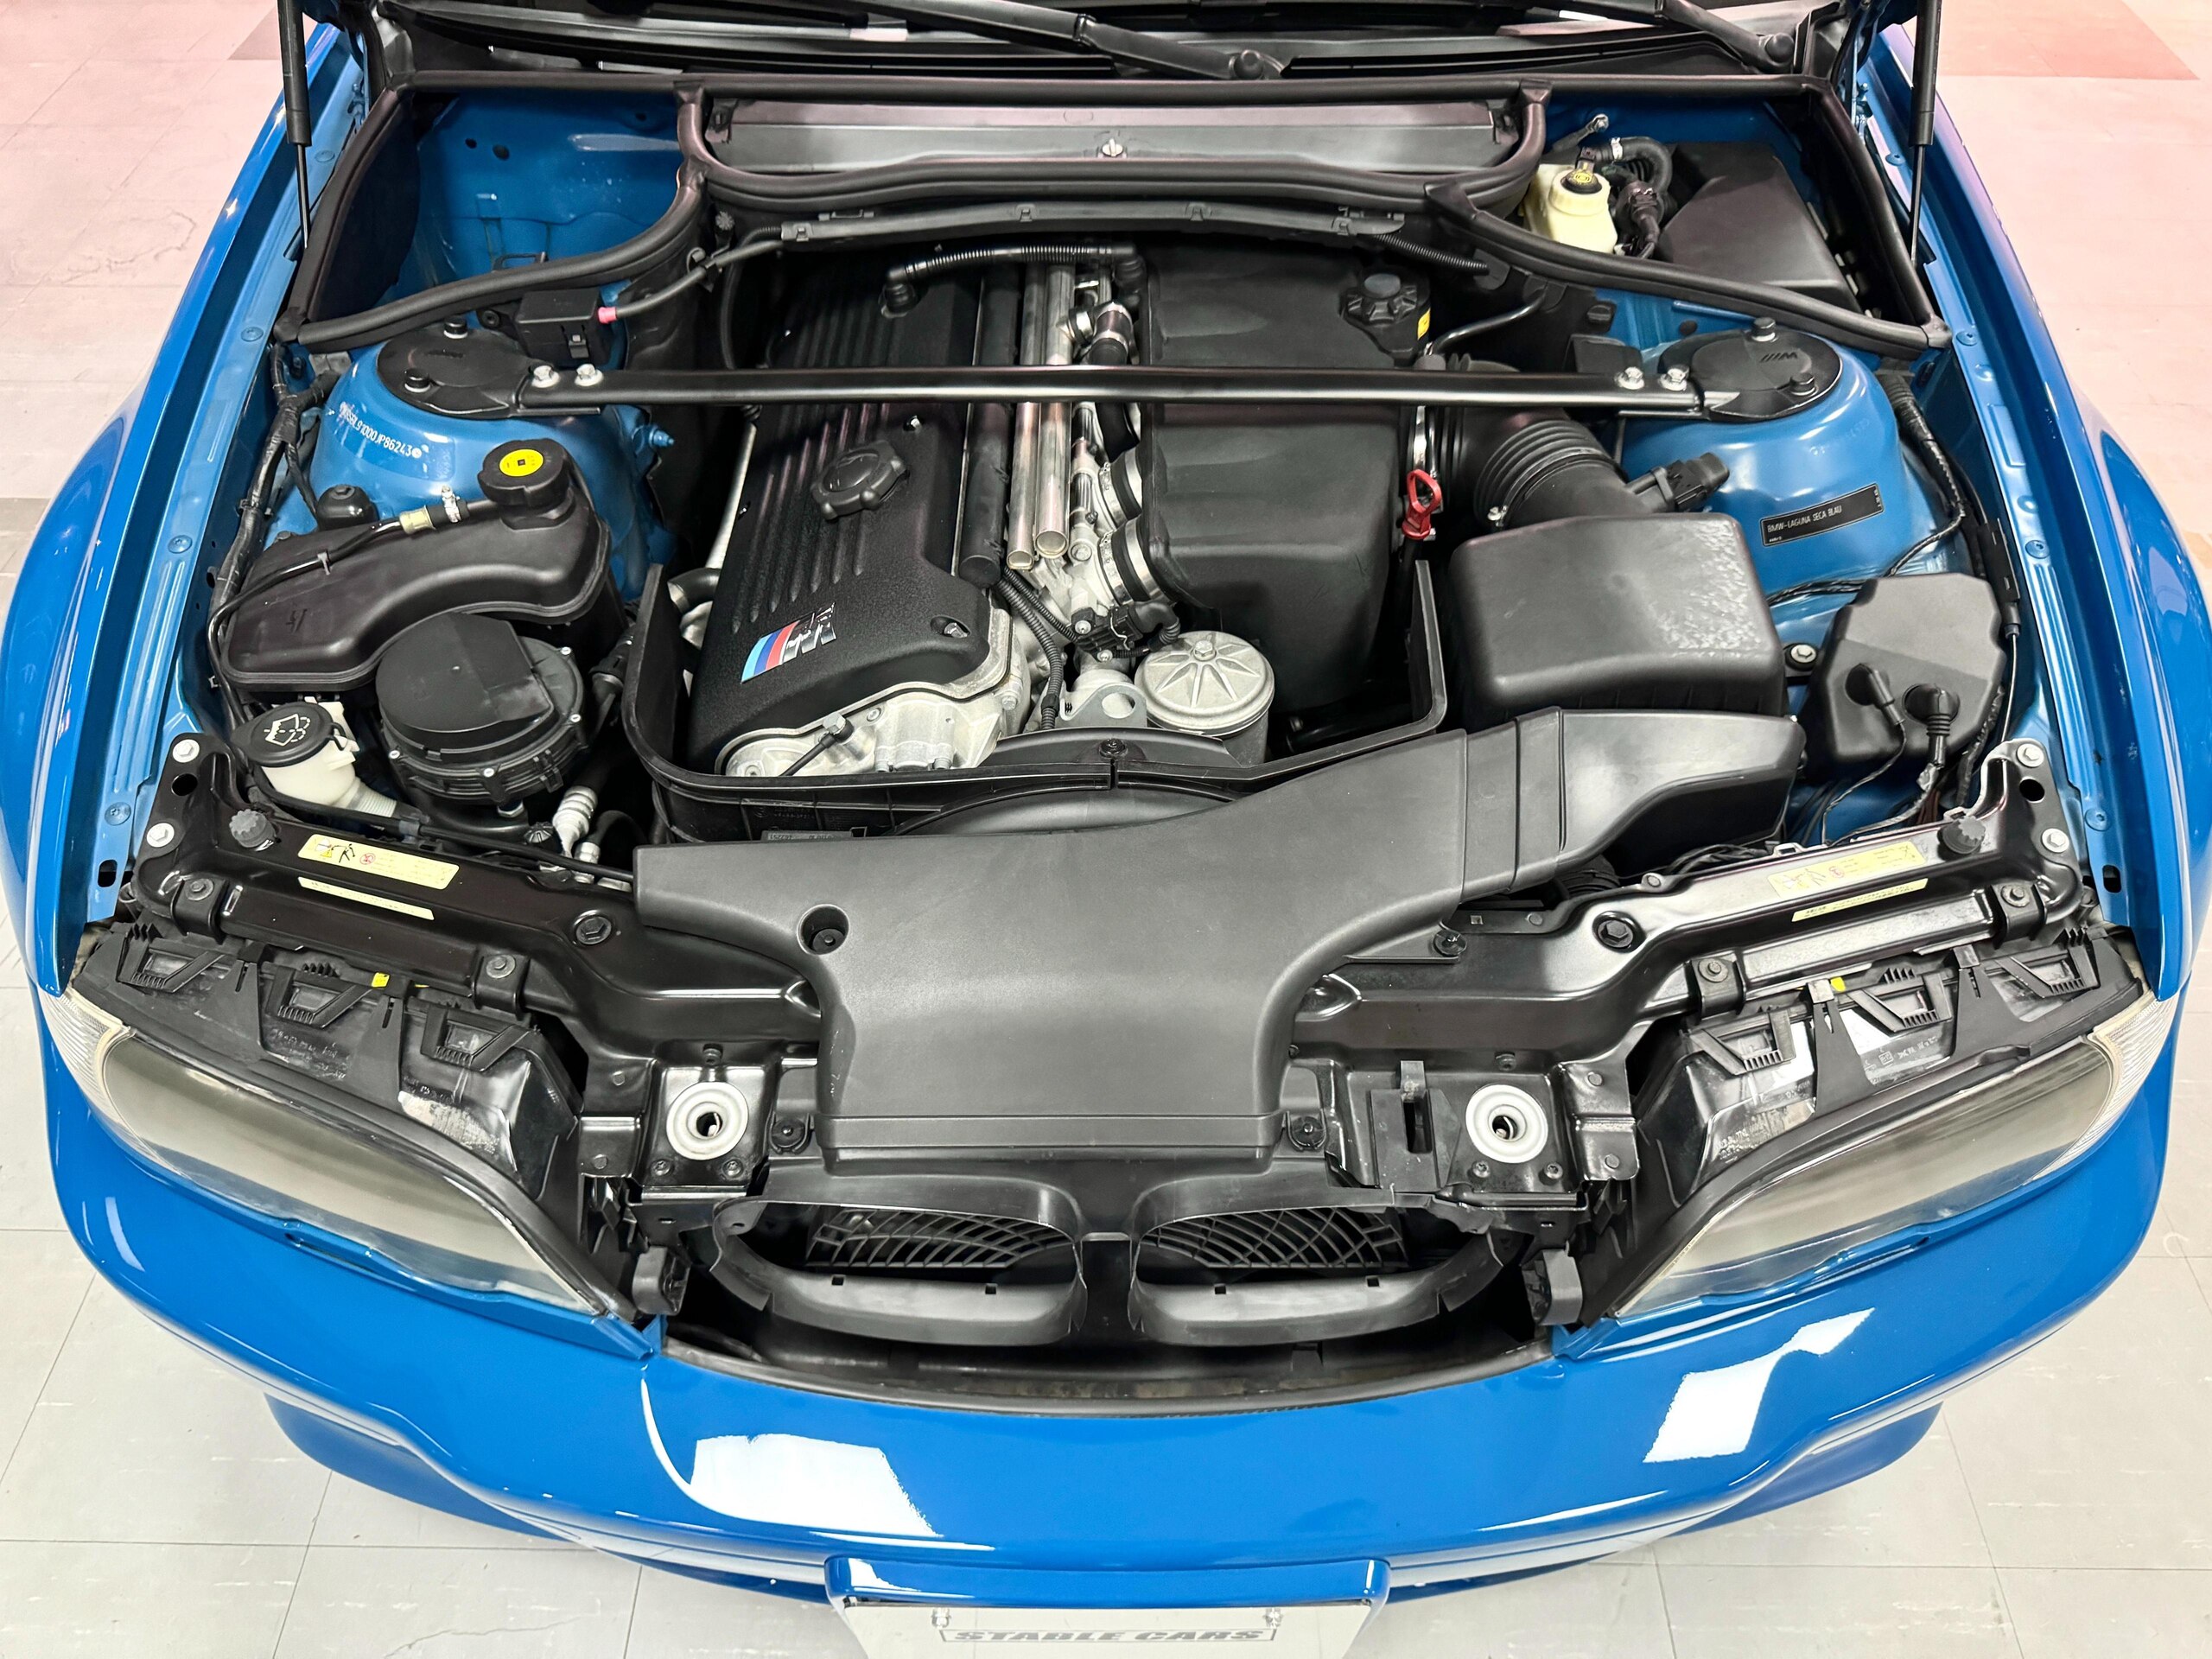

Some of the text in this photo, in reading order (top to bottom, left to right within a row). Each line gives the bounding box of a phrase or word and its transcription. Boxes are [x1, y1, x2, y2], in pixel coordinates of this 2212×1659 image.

[1813, 512, 1827, 522] SECA
[1827, 505, 1842, 517] BLAU
[954, 1630, 1263, 1641] STABLE CARS
